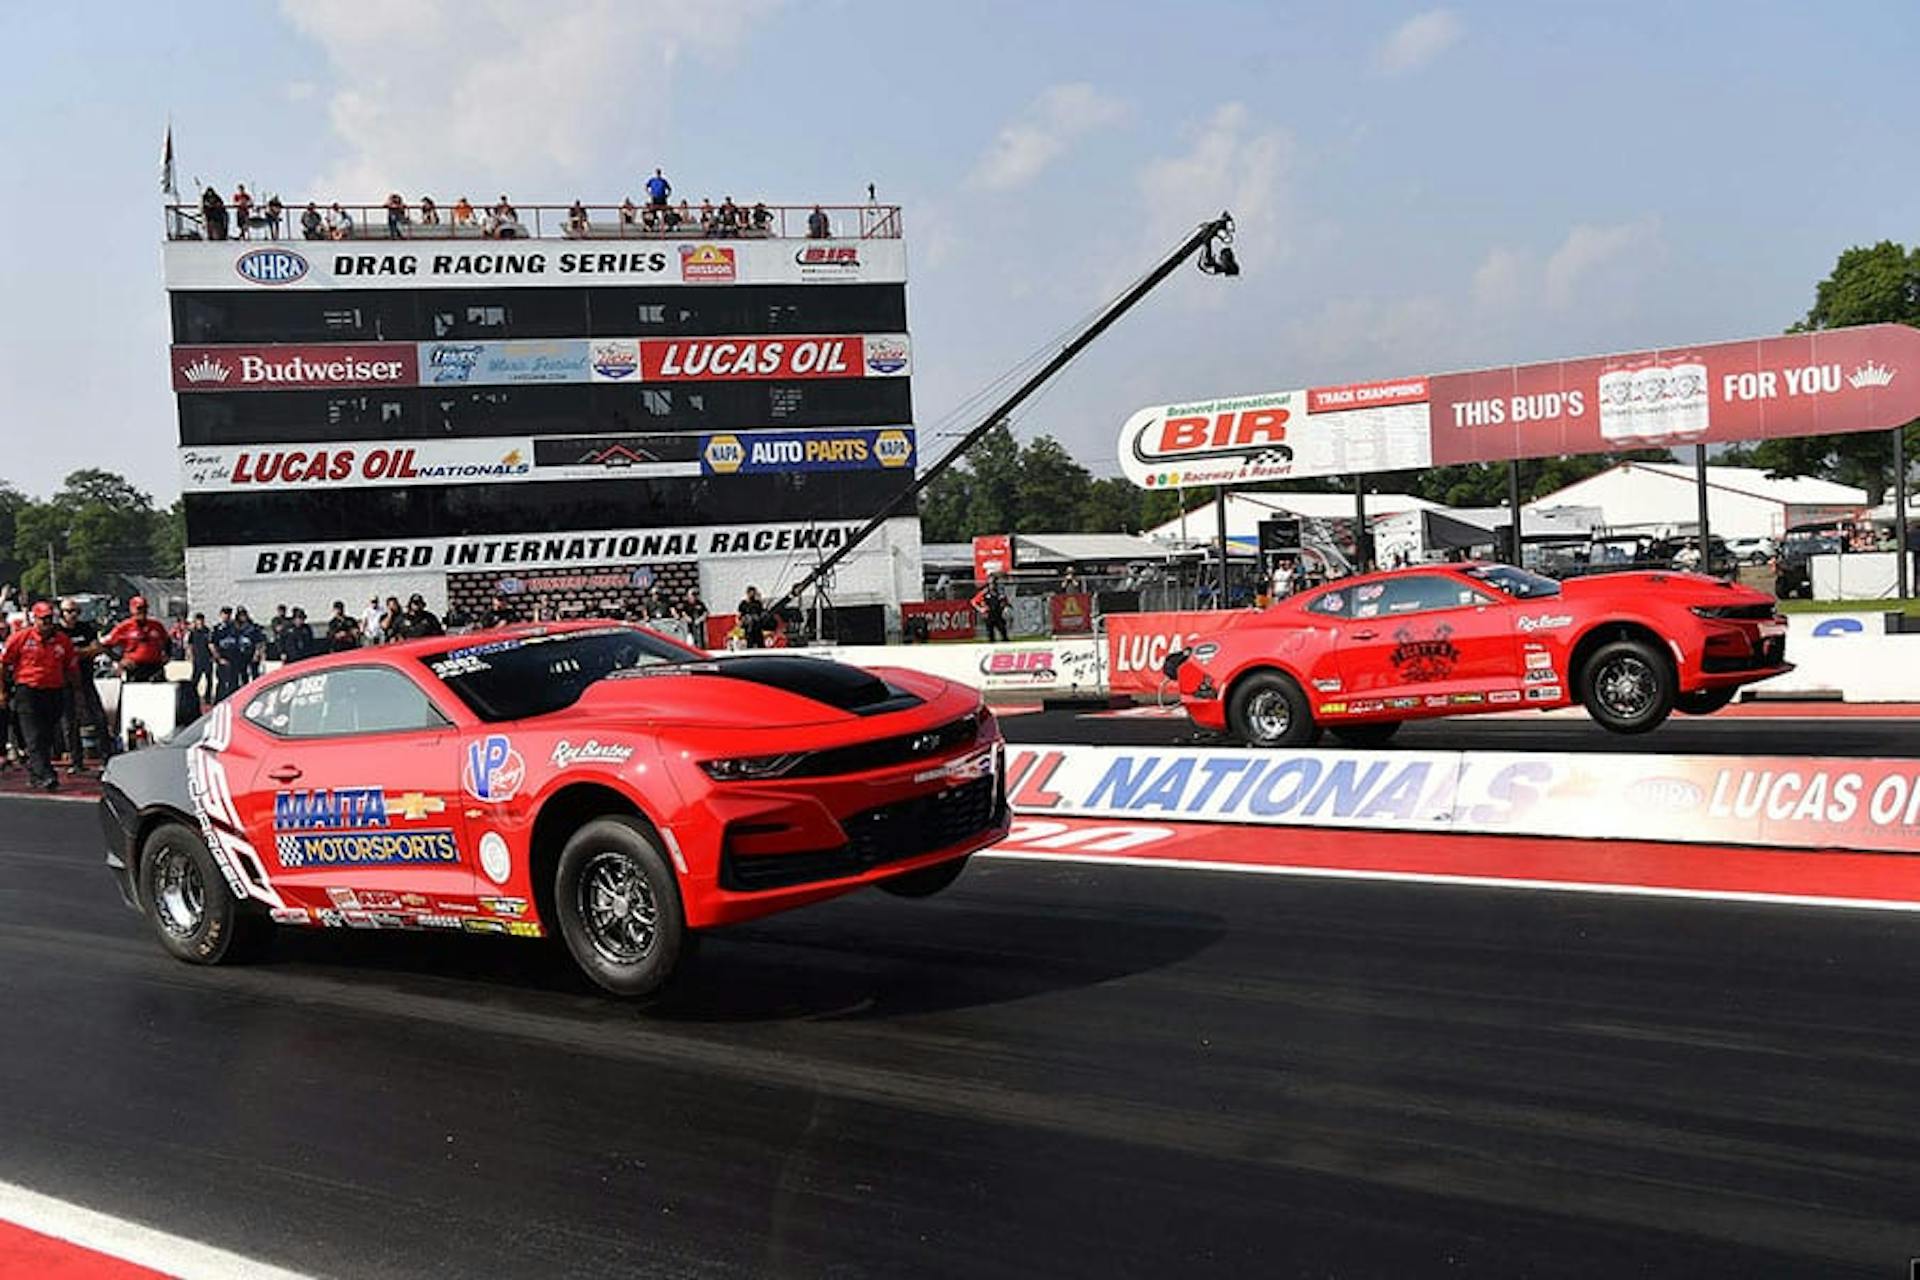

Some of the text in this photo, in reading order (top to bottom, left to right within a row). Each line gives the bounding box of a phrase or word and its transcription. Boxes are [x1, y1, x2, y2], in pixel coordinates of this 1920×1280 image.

[243, 253, 303, 281] NHRA
[333, 252, 667, 277] DRAG RACING SERIES
[239, 355, 403, 383] Budweiser
[660, 340, 850, 377] LUCAS OIL
[1452, 400, 1506, 428] THIS
[1510, 390, 1585, 421] BUD'S
[1723, 370, 1778, 401] FOR
[1782, 364, 1843, 396] YOU
[1158, 408, 1292, 453] BIR
[231, 448, 530, 484] LUCAS OIL NATIONALS
[751, 438, 868, 465] AUTO PARTS
[1181, 469, 1236, 484] Raceway
[1250, 464, 1292, 477] Resort
[255, 526, 861, 574] BRAINERD INTERNATIONAL RACEWAY
[990, 651, 1055, 673] BIR
[1117, 632, 1200, 673] LUCA
[470, 735, 511, 799] VP
[552, 740, 580, 768] Ray
[275, 786, 391, 829] MAITA
[1082, 756, 1554, 824] NATIONALS
[1707, 769, 1920, 826] LUCAS OI
[305, 833, 455, 862] MOTORSPORTS
